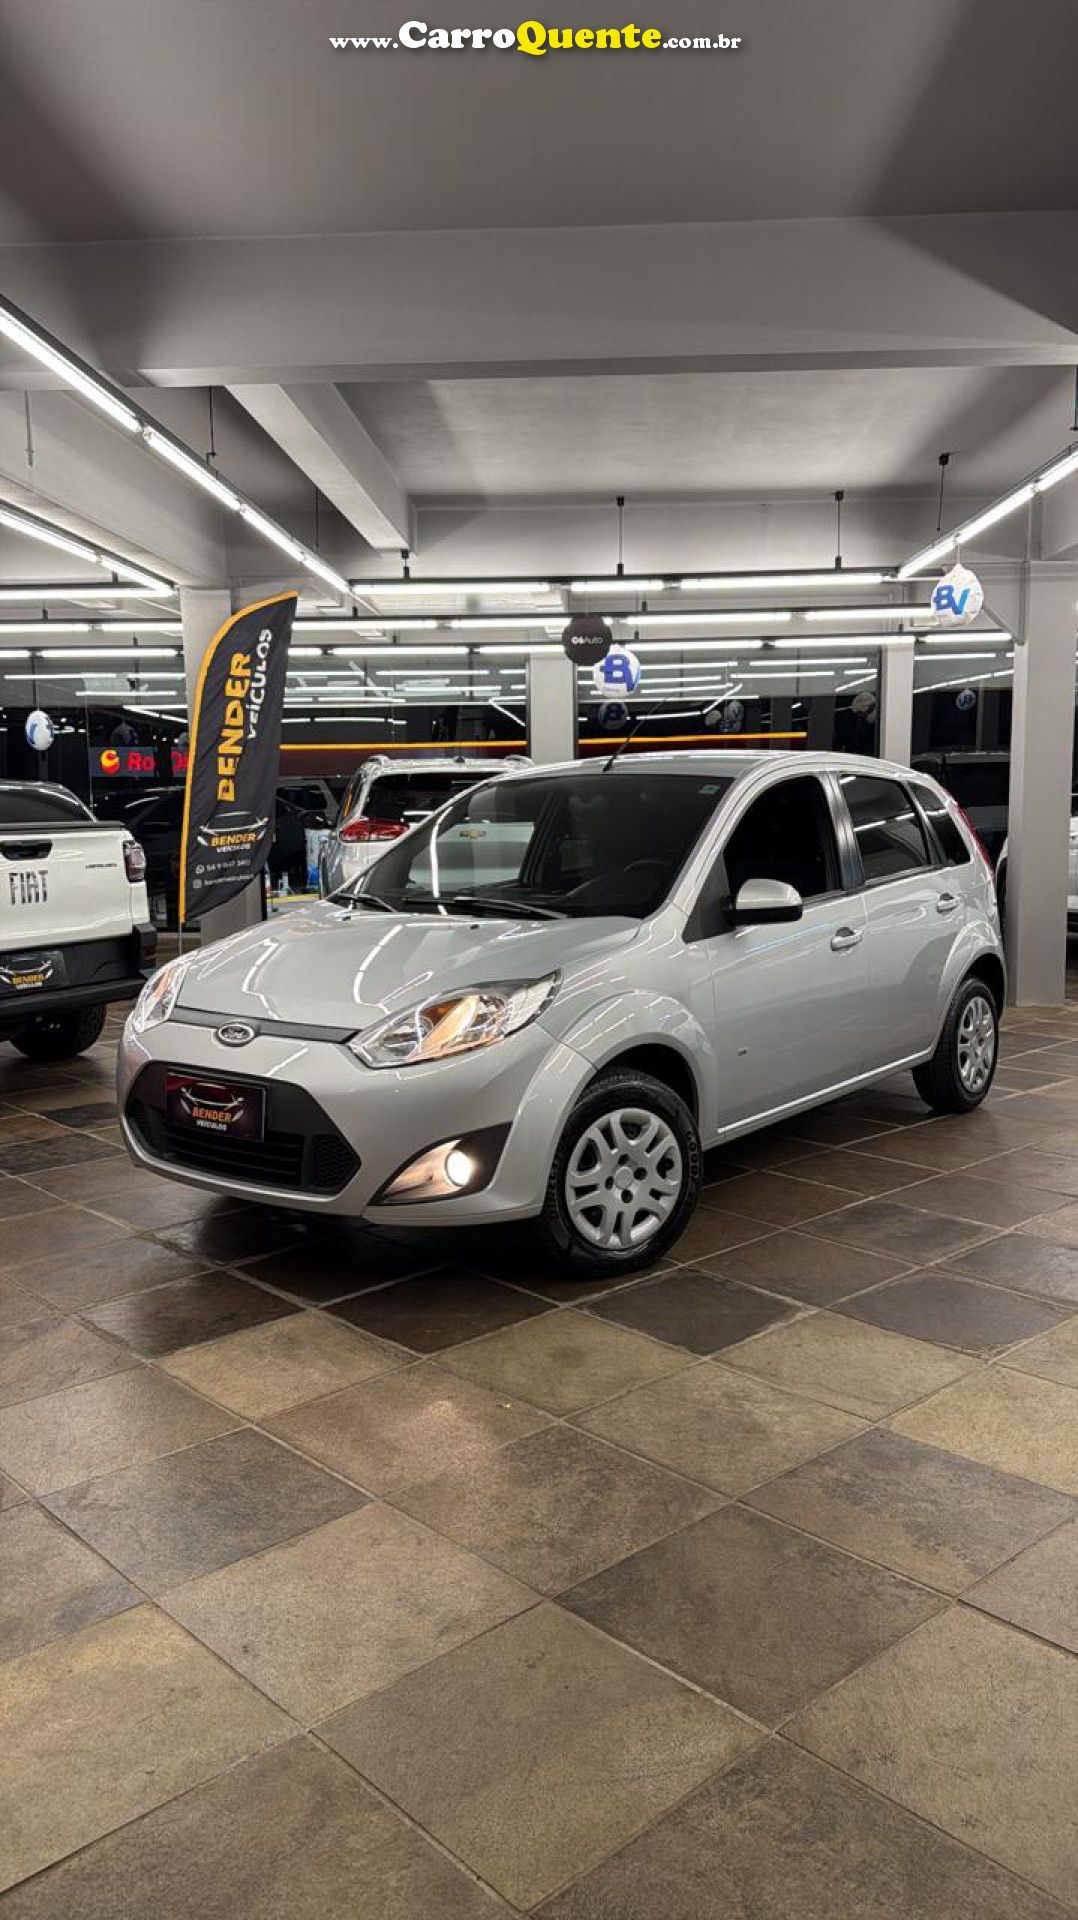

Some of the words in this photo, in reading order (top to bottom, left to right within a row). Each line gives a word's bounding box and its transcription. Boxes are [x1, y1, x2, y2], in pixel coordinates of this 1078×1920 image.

[933, 584, 971, 616] BV
[216, 651, 252, 802] BENDER
[9, 869, 49, 905] FIAT
